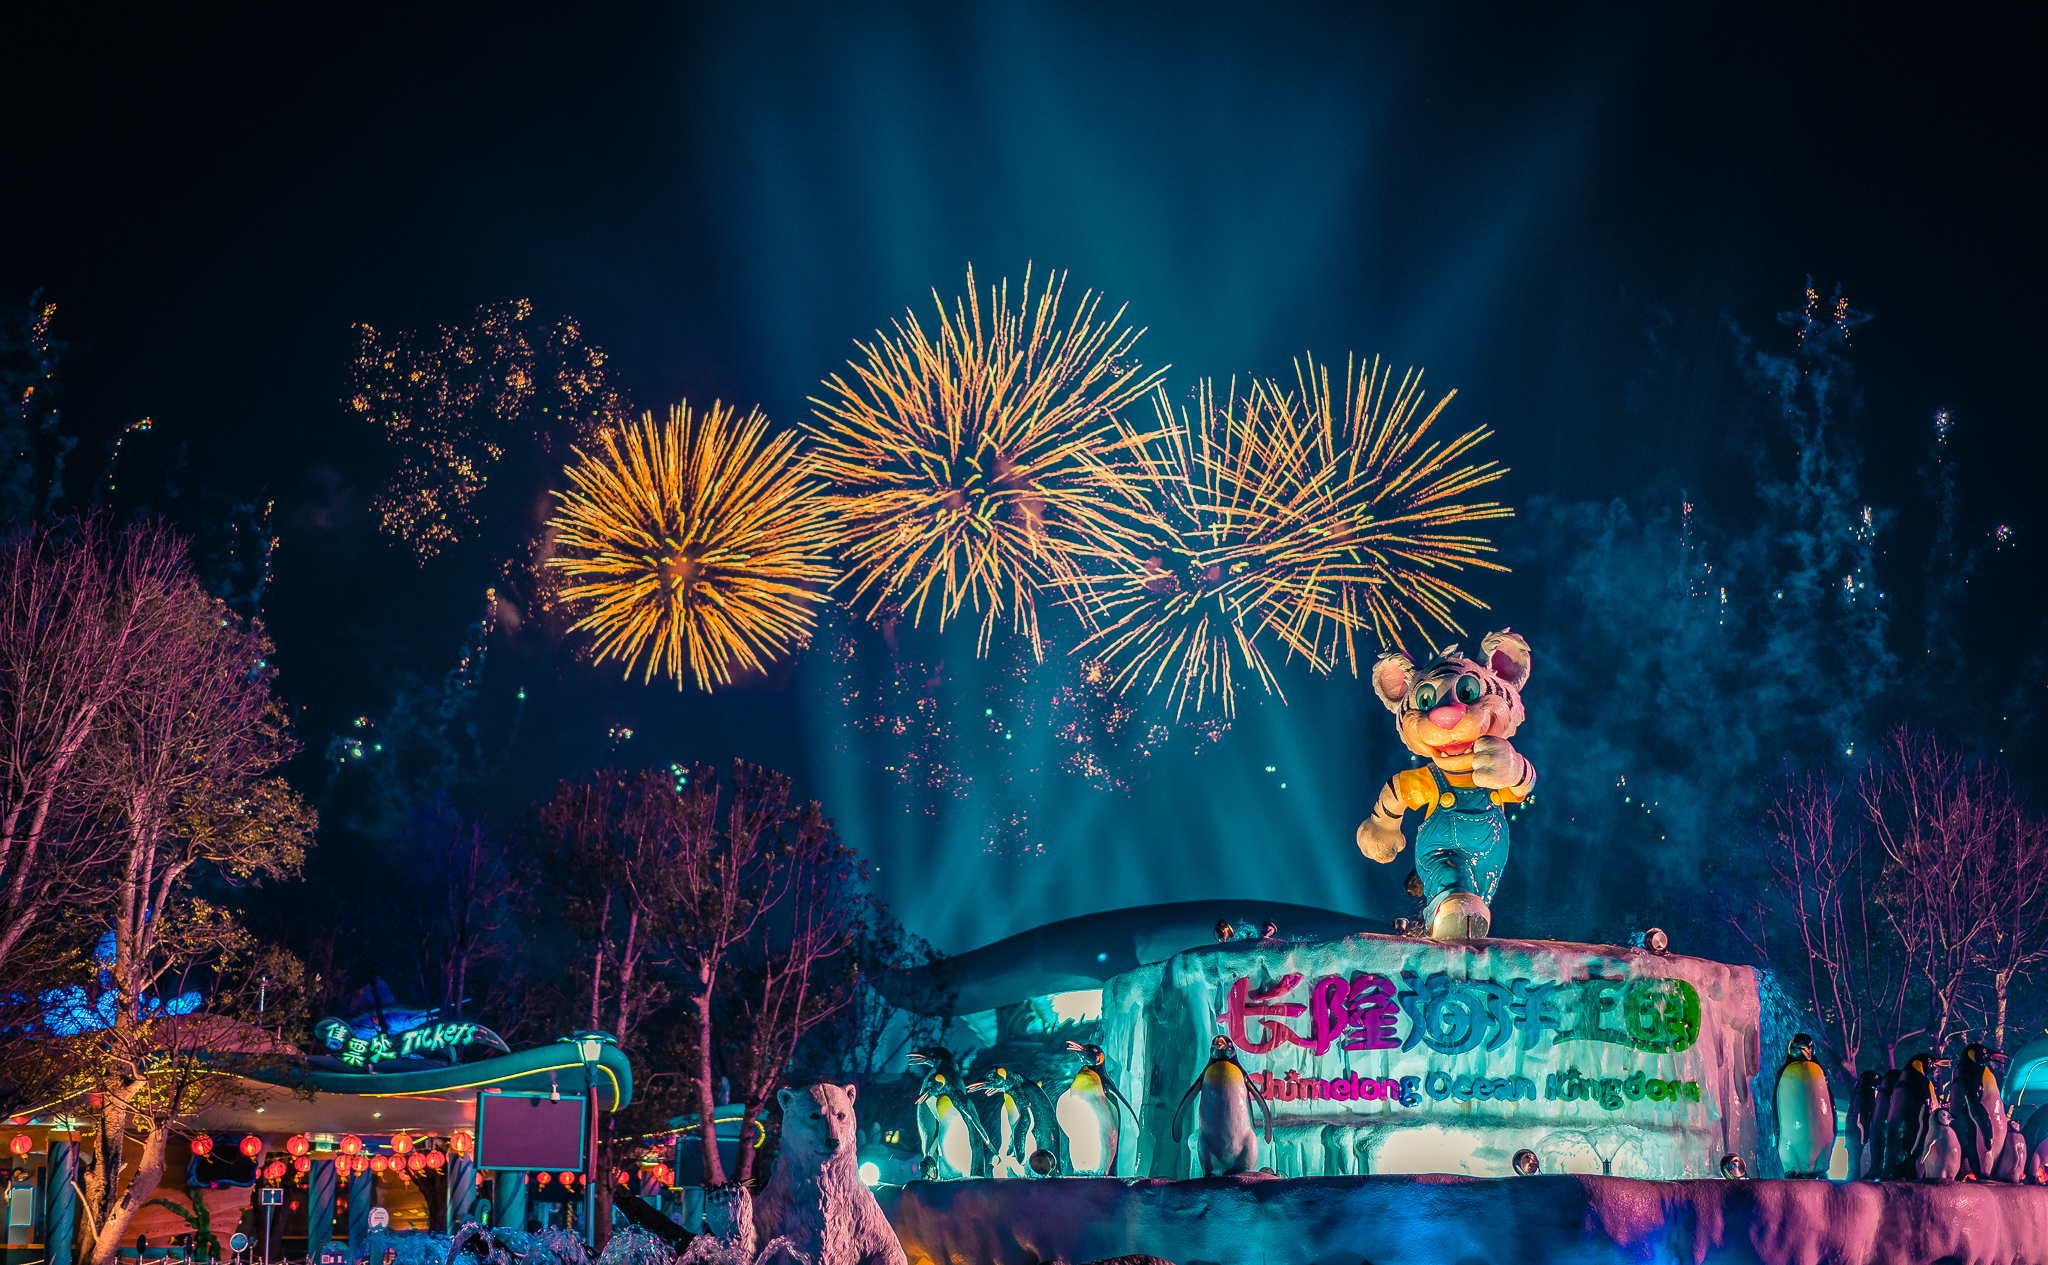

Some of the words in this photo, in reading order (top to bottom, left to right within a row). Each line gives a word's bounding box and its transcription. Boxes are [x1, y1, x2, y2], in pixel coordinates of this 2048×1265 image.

[1216, 970, 1702, 1057] 长隆海洋王国
[325, 1022, 397, 1067] 售票处
[401, 1023, 479, 1056] Tickets
[1425, 1071, 1537, 1102] Ocean
[1545, 1066, 1701, 1111] Kingdom
